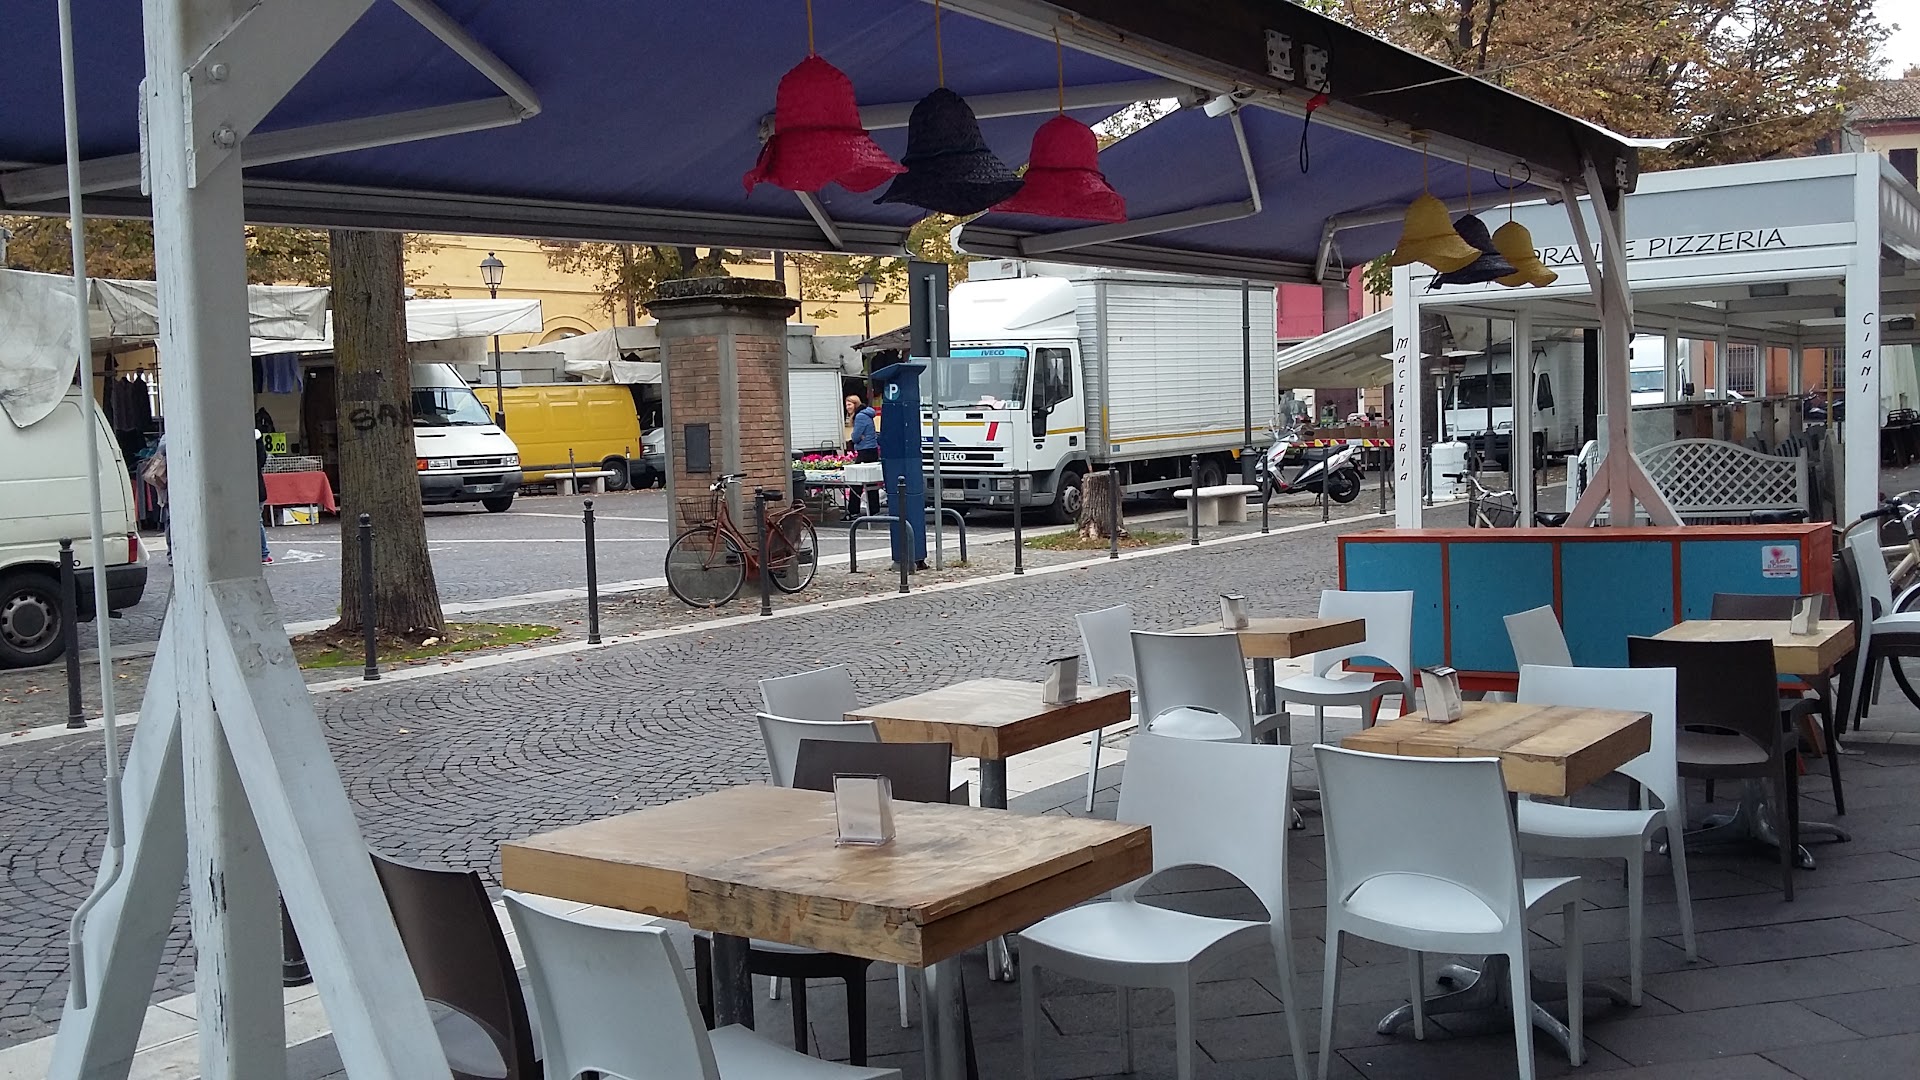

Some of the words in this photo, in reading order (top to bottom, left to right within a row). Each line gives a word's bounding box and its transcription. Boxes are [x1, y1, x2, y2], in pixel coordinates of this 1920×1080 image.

[1649, 228, 1787, 257] PIZZERIA
[980, 349, 1006, 357] IVECO
[1861, 312, 1875, 393] CIANI
[888, 383, 899, 400] P
[1396, 337, 1409, 481] MACELLERIA
[940, 452, 967, 461] IVECO
